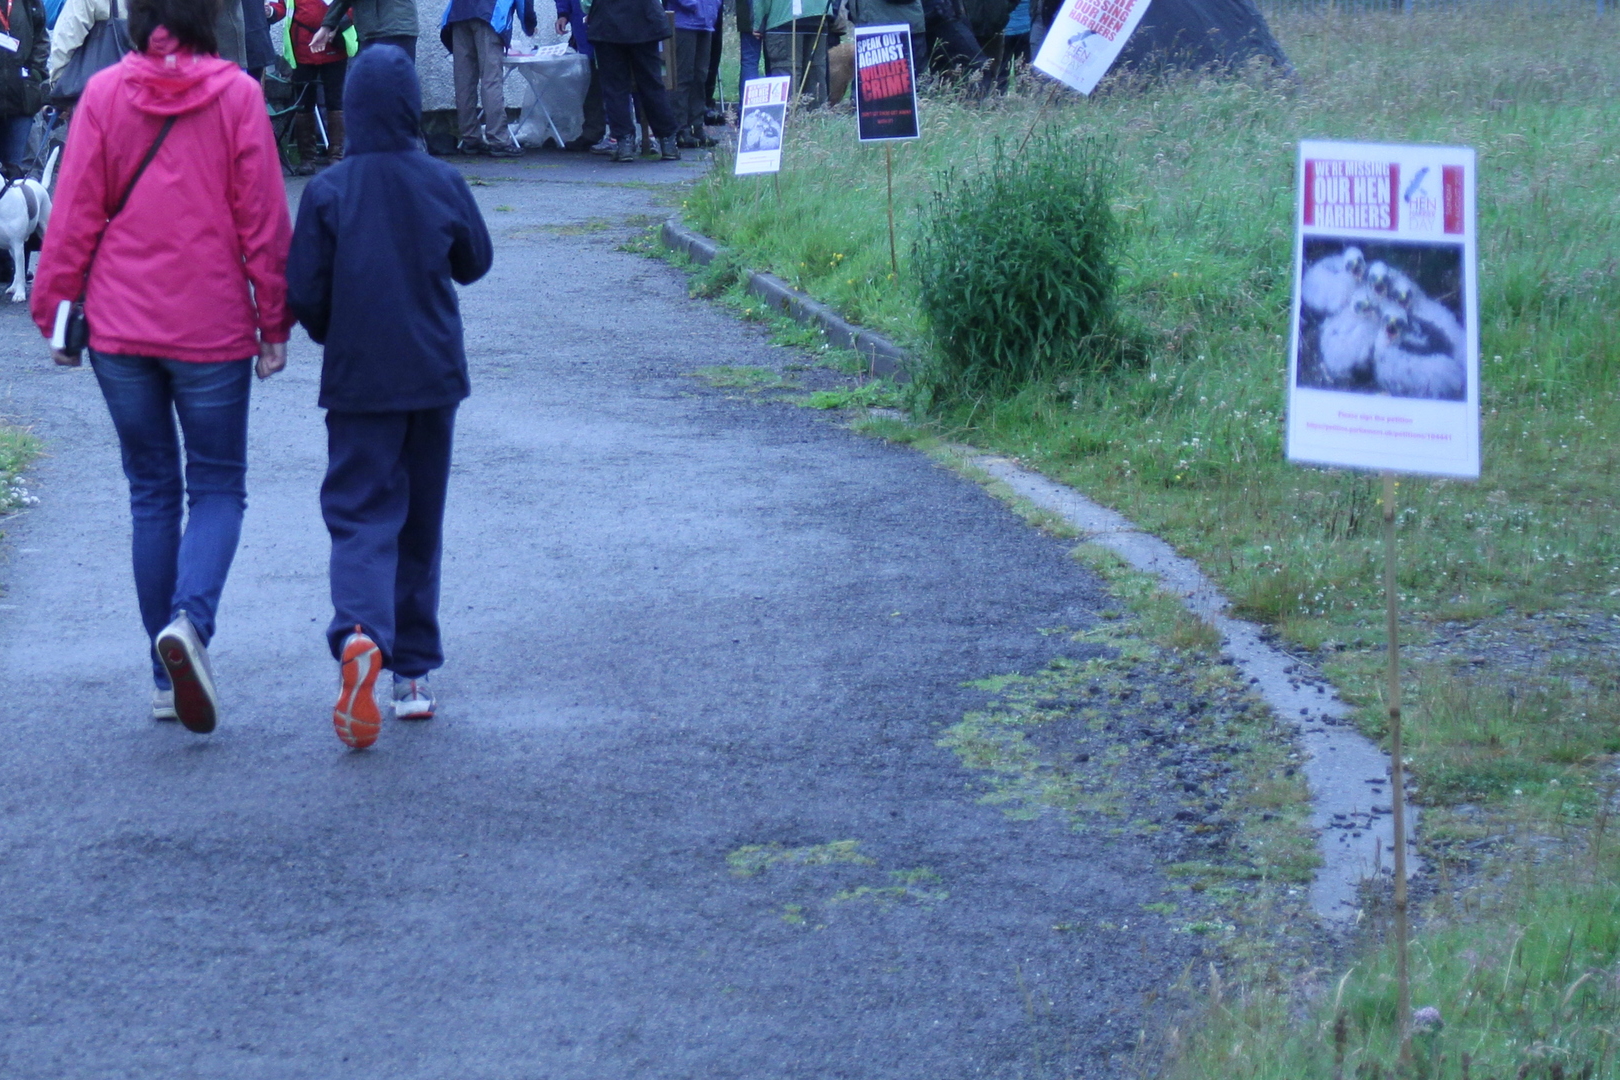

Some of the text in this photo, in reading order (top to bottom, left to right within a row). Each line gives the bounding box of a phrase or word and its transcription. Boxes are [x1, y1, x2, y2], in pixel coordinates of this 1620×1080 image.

[1069, 9, 1116, 42] HARRIERS
[1074, 0, 1124, 33] OUR HEN
[857, 32, 901, 54] SPEAK OUT
[859, 44, 904, 69] AGAINST
[860, 58, 908, 82] WILDLIFE
[862, 73, 911, 102] CRIME
[1345, 161, 1390, 177] MISSING
[1315, 176, 1390, 204] OUR HEN
[1409, 196, 1437, 210] HEN
[1315, 204, 1391, 229] HARRIERS
[1386, 415, 1414, 425] petition
